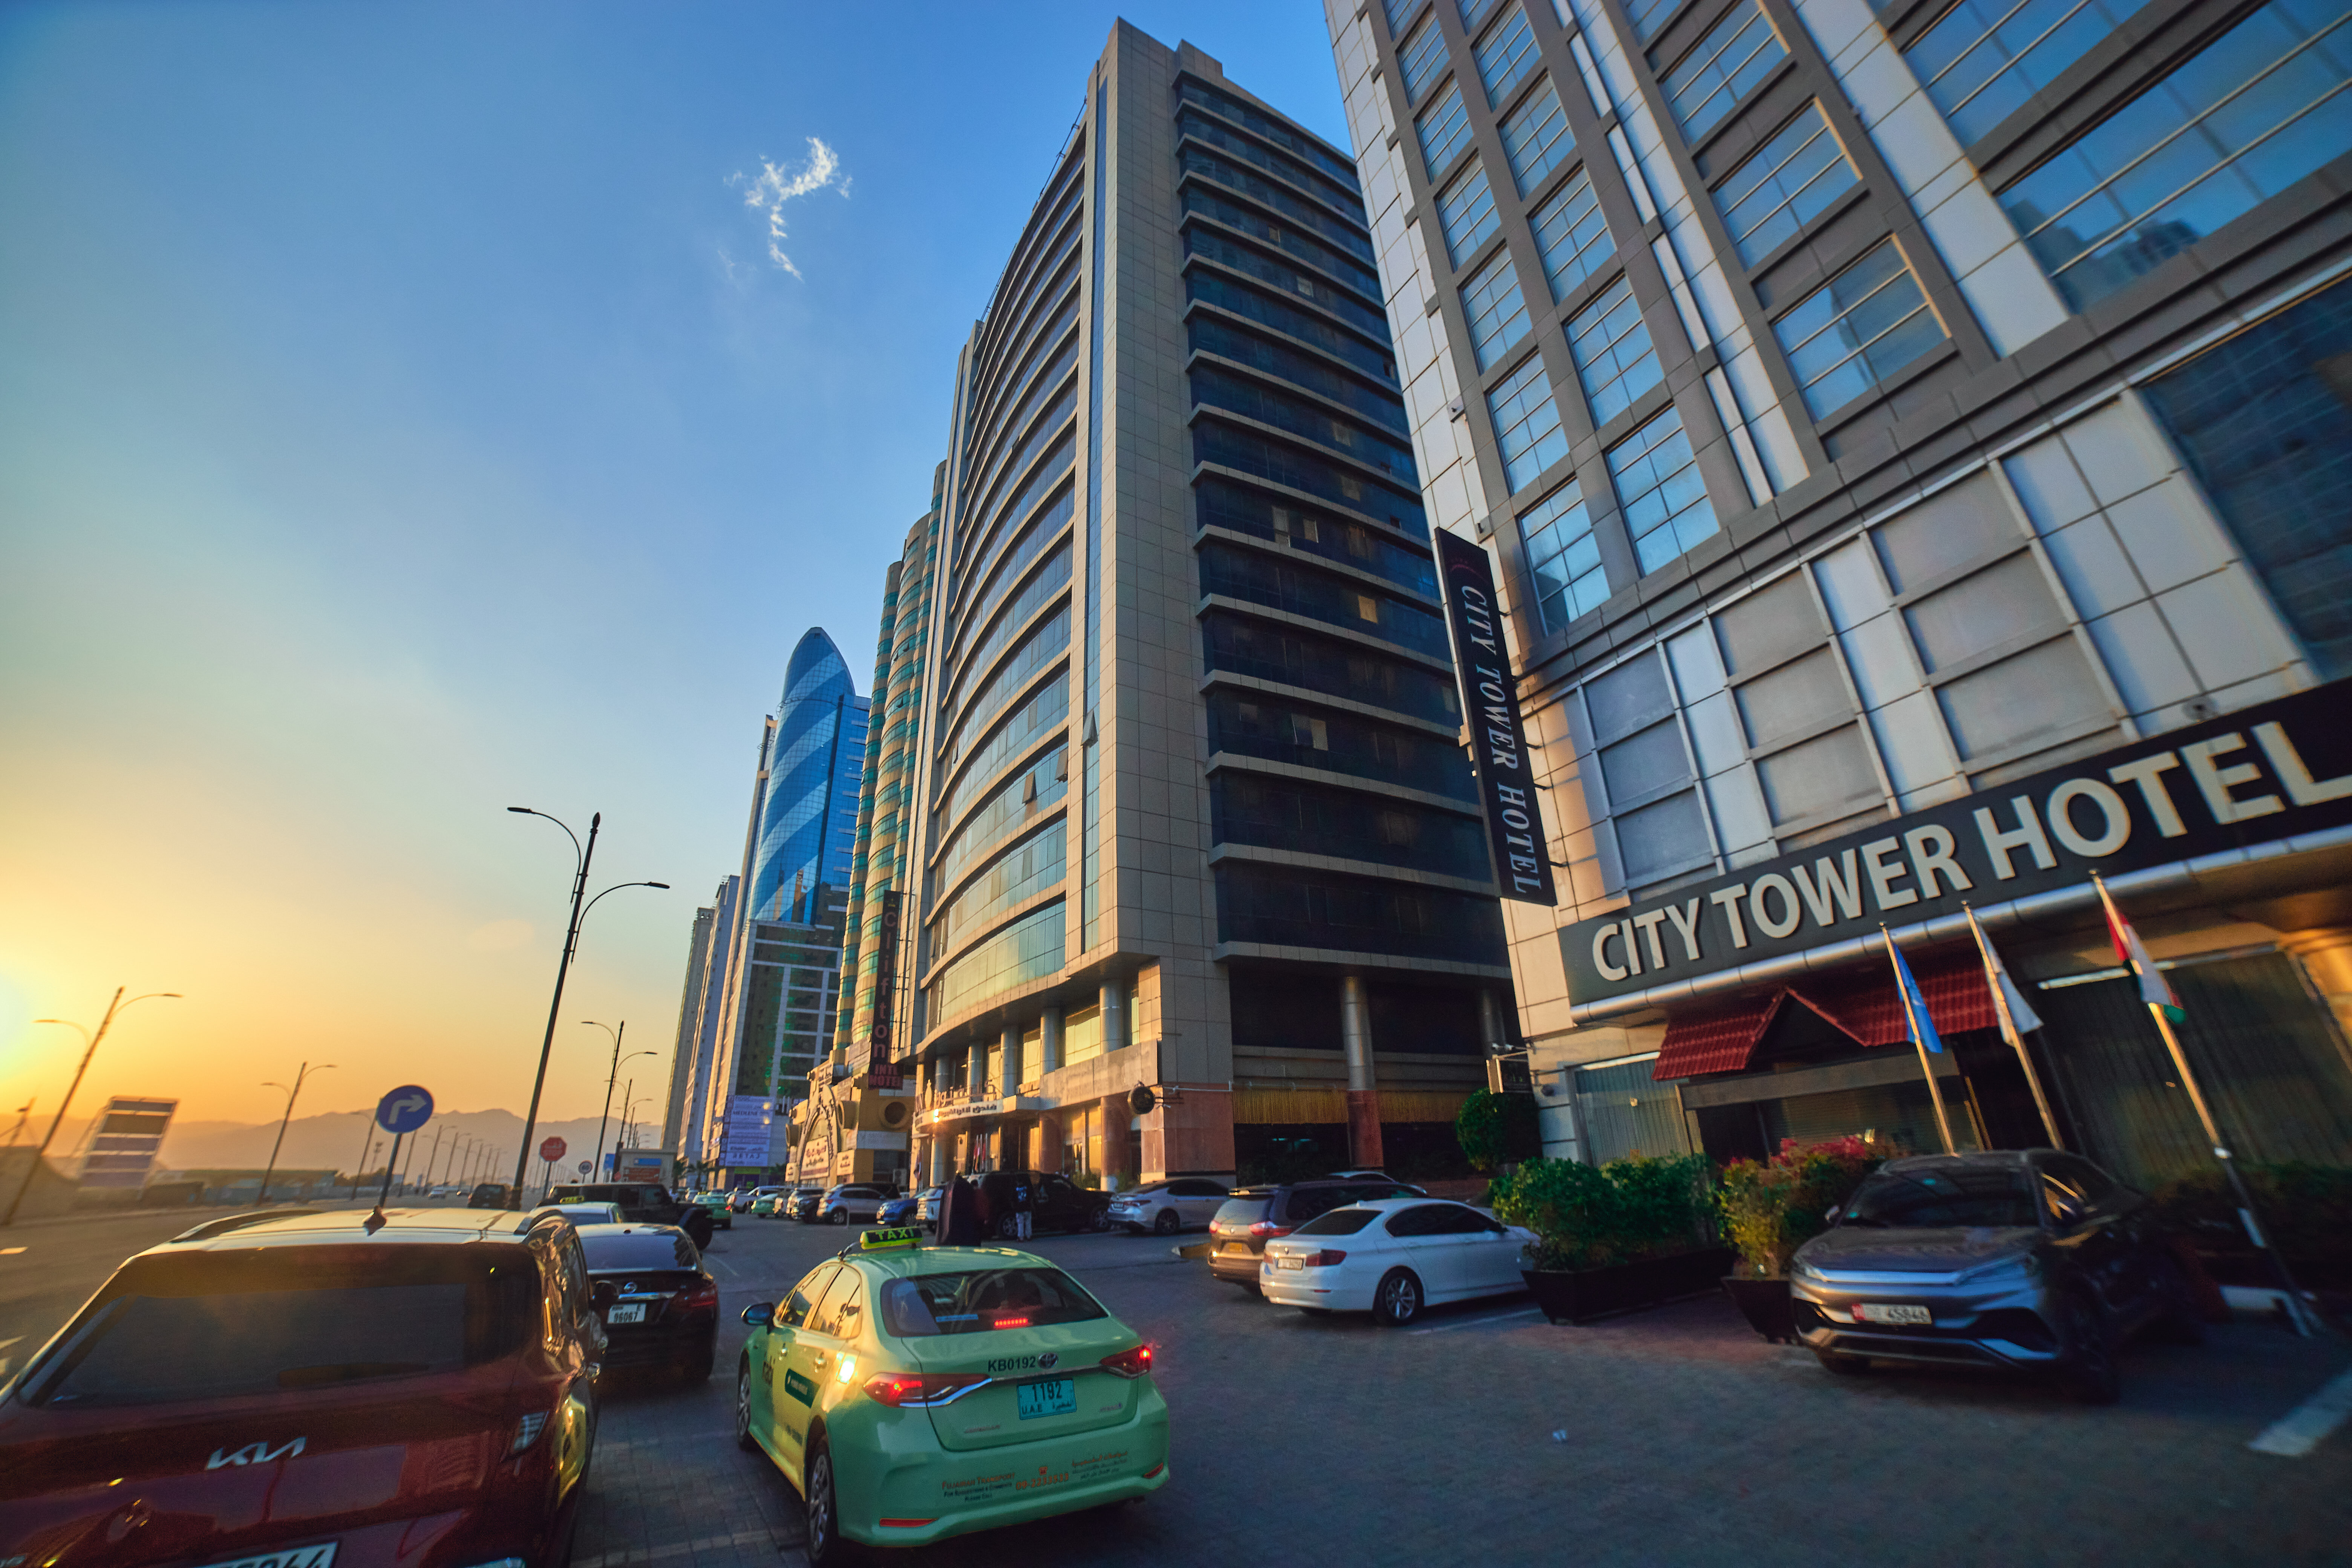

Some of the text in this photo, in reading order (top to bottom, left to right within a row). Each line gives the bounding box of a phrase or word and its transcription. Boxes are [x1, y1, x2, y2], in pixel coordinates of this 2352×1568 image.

[1461, 585, 1542, 894] CITY TOWER HOTEL
[1591, 720, 2352, 982] CITY TOWER HOTEL
[874, 911, 897, 1058] Clifton
[870, 1075, 902, 1086] HOTEL
[875, 1228, 914, 1240] TAXI
[988, 1356, 1036, 1372] KB0192
[1032, 1382, 1063, 1402] 1192
